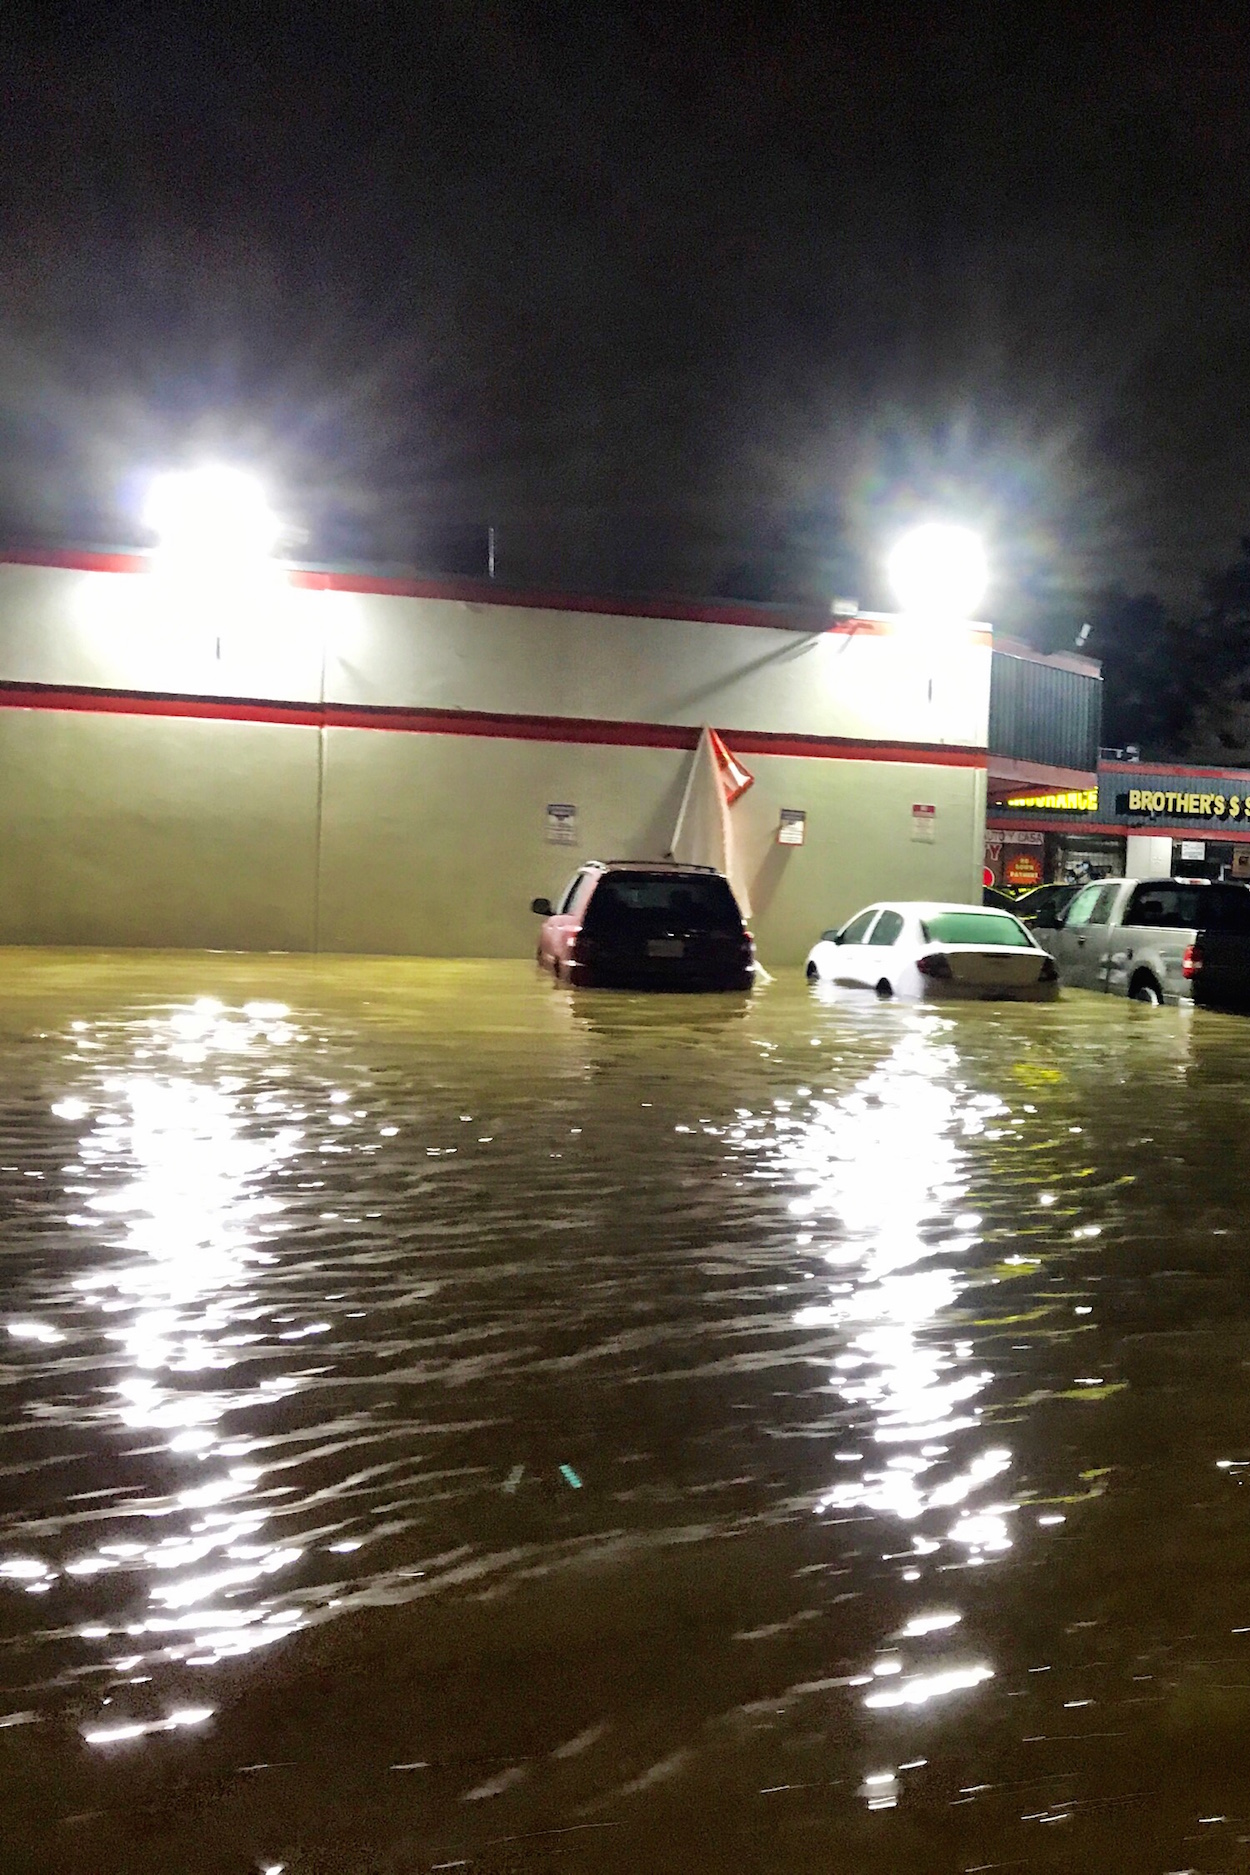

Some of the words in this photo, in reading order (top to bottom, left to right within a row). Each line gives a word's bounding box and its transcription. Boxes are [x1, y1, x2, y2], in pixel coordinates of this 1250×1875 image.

[1128, 790, 1225, 816] BROTHER'S
[1229, 795, 1240, 818] $
[985, 831, 1005, 842] UTO
